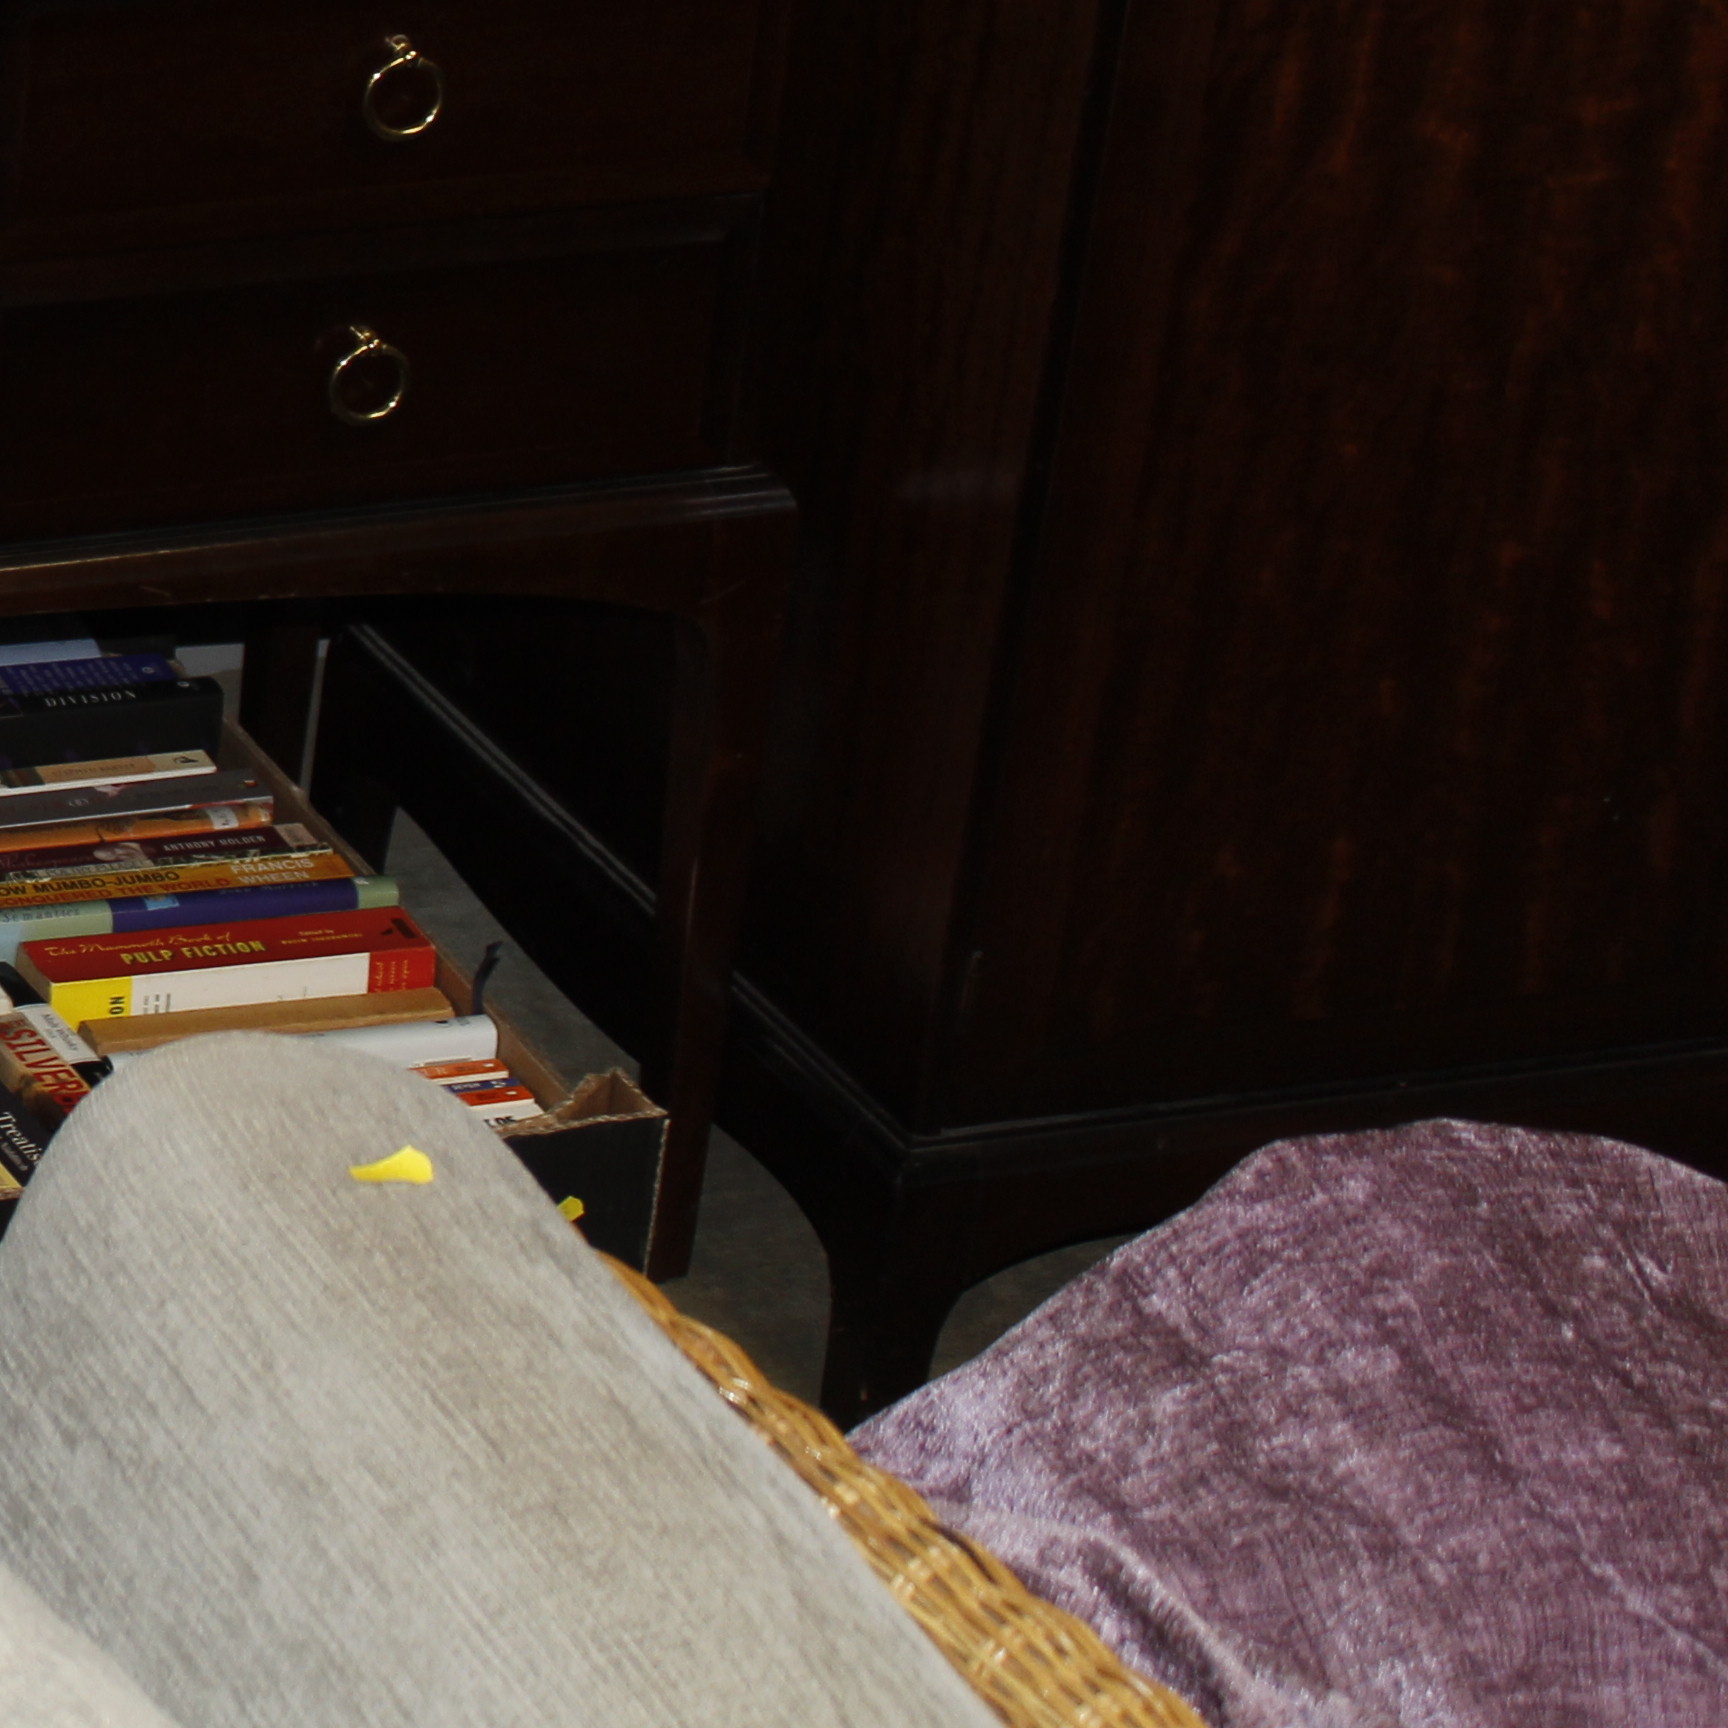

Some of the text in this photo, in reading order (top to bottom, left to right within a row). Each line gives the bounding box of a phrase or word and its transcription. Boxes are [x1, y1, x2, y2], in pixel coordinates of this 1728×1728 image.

[44, 690, 138, 708] DIVISION
[163, 835, 266, 852] ANTHONY HOLDEN
[230, 858, 315, 875] FRANCIS
[33, 872, 180, 894] MUMBO-JUMBO
[116, 884, 155, 896] THE
[157, 877, 231, 894] WORLD
[238, 871, 310, 884] WHEEN
[3, 907, 80, 923] Semantics
[45, 931, 231, 957] The Mammoth Book of
[121, 940, 266, 966] PULP FICTION
